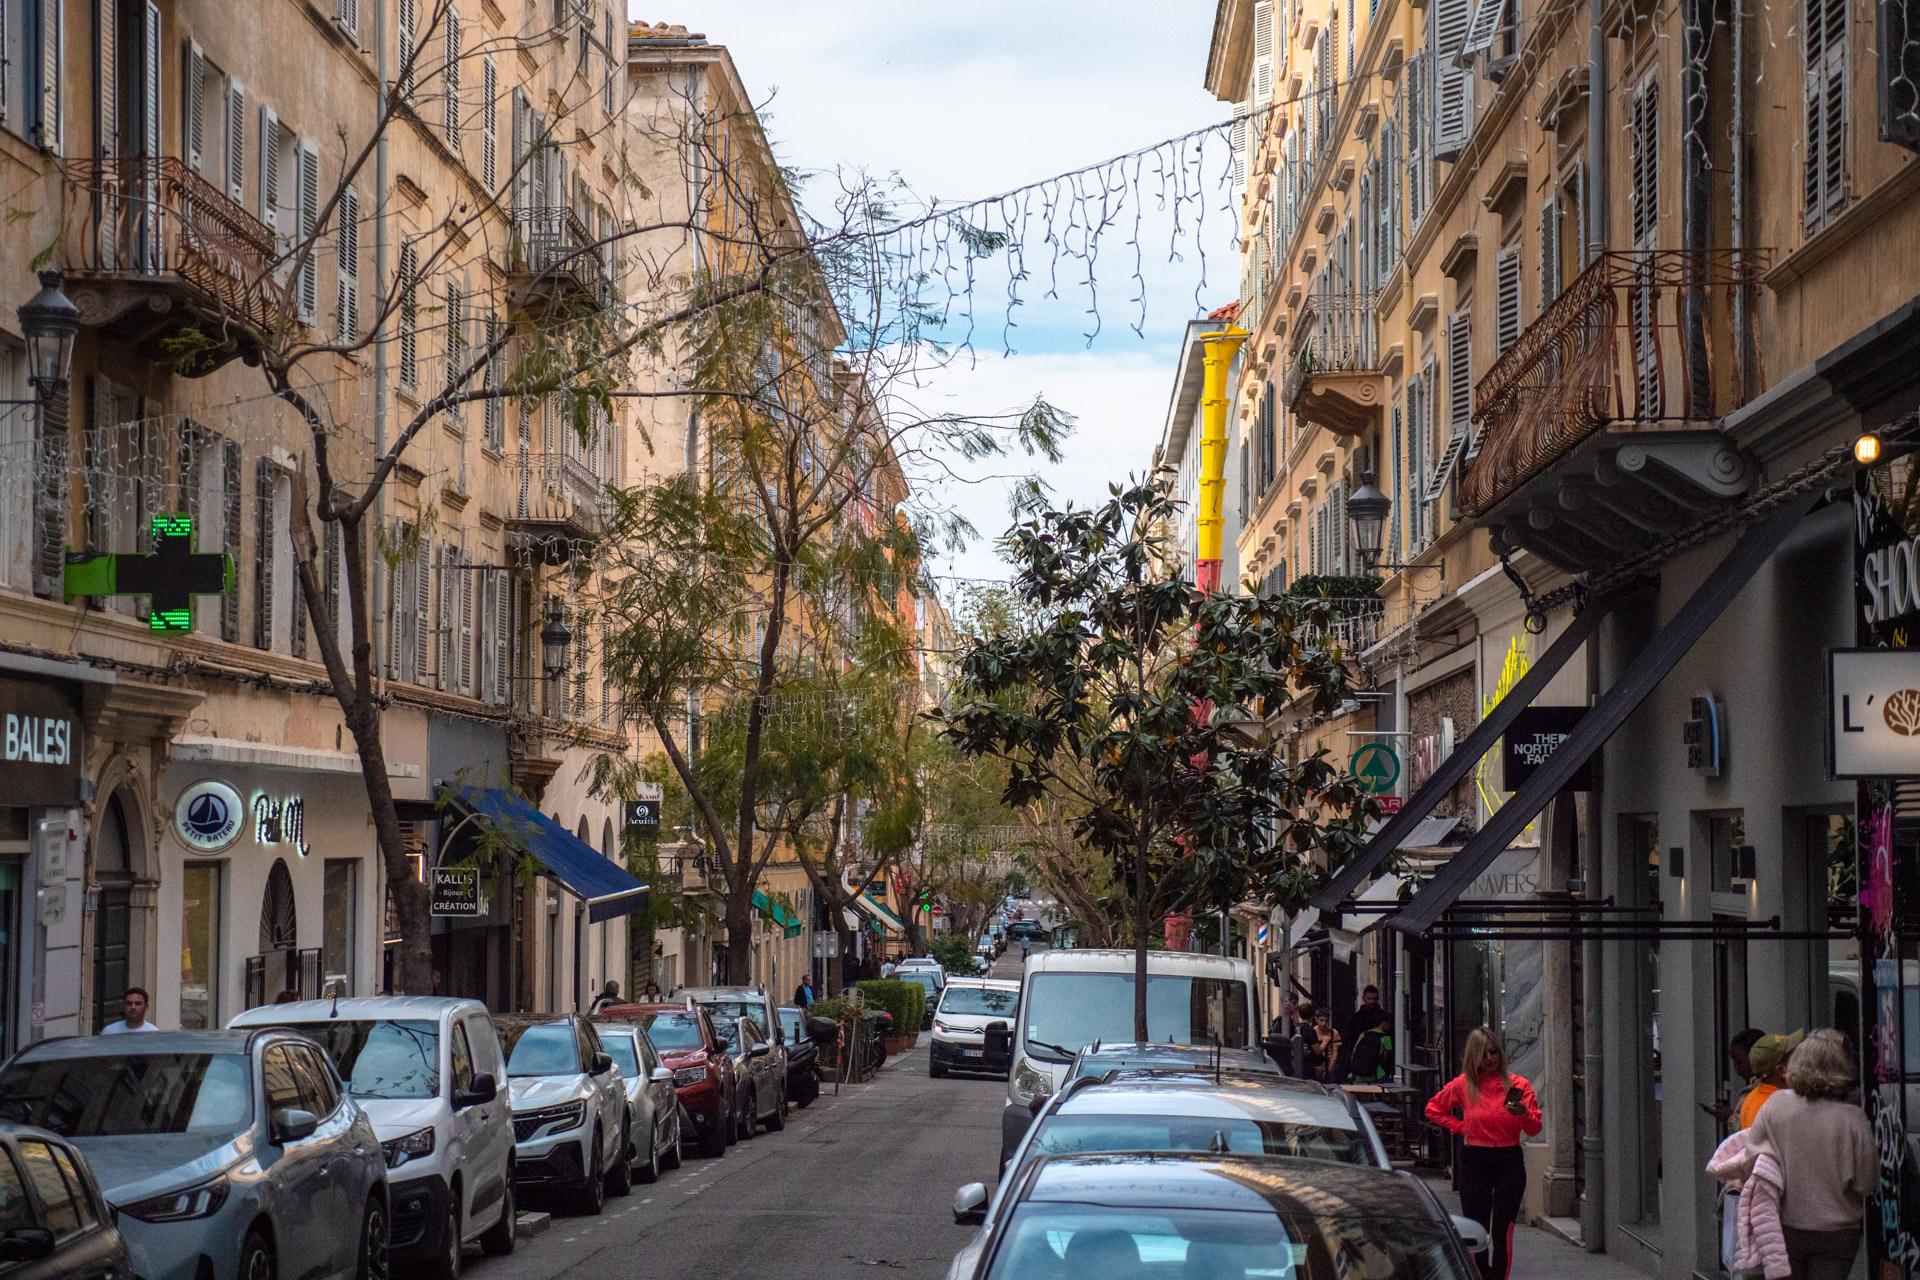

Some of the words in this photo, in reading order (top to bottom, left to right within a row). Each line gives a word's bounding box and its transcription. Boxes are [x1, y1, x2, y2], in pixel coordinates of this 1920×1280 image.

[6, 713, 71, 765] BALESI
[1533, 733, 1558, 744] THE
[1526, 754, 1550, 765] FAC
[182, 821, 203, 841] PETIT
[206, 820, 235, 842] BATEAU
[1467, 873, 1537, 894] RAVERS
[433, 900, 476, 910] CRÉATION
